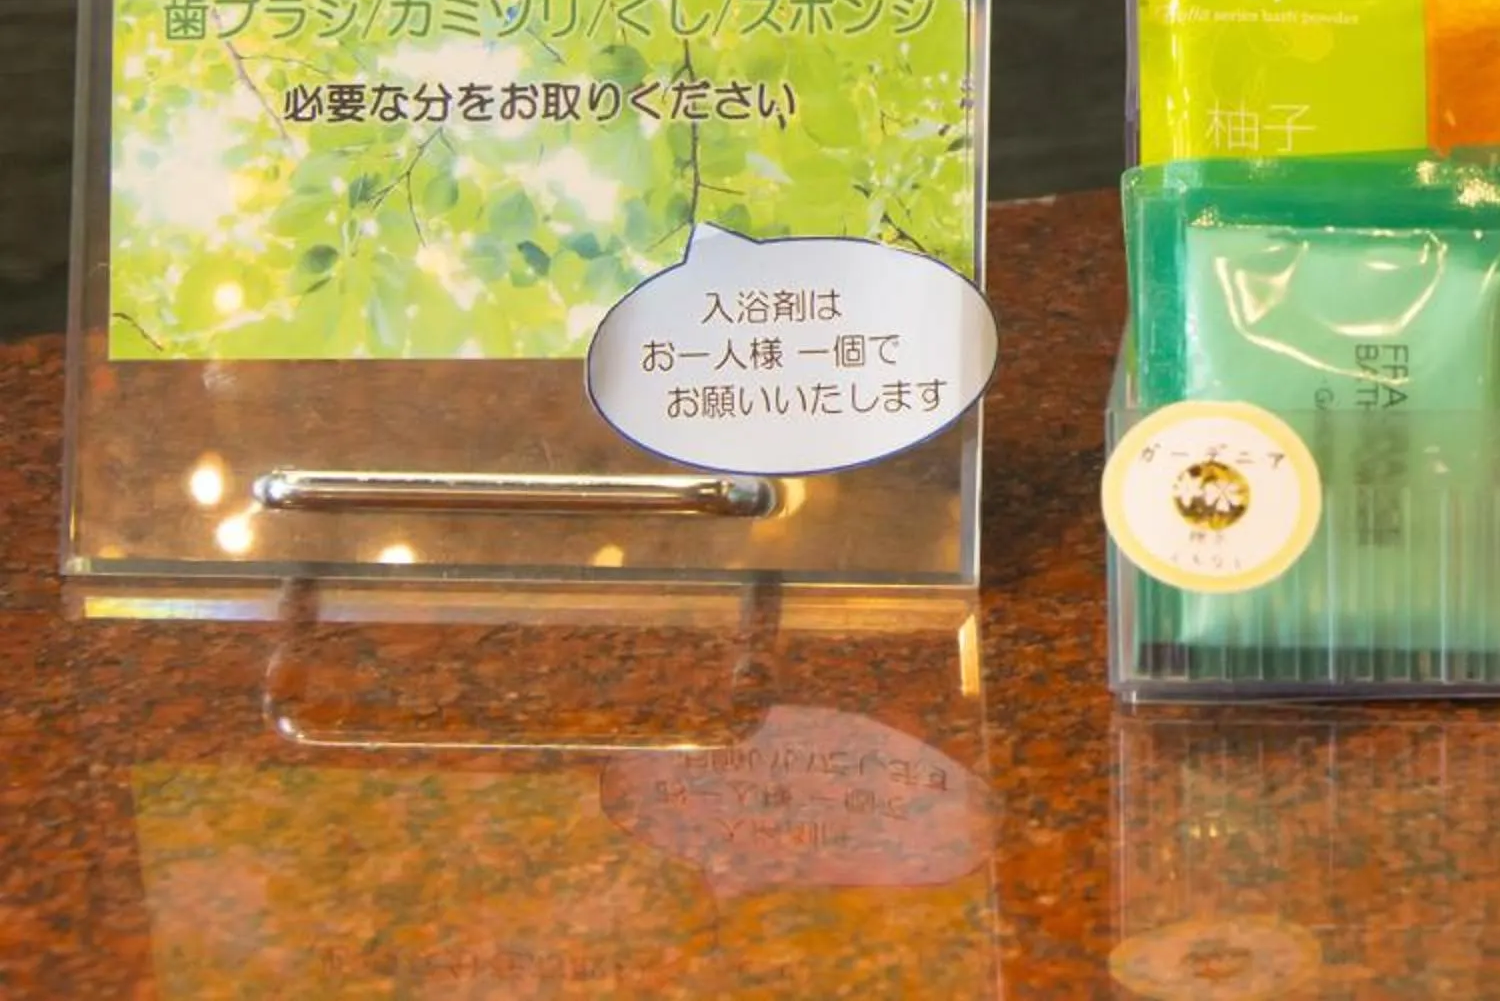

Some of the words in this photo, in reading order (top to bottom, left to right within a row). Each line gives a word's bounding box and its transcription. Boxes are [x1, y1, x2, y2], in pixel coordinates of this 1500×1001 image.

[283, 80, 797, 125] 必要な分をお取りください
[1205, 100, 1318, 153] 柚子
[701, 288, 842, 325] 入浴剤は
[667, 378, 948, 419] お願いいたします
